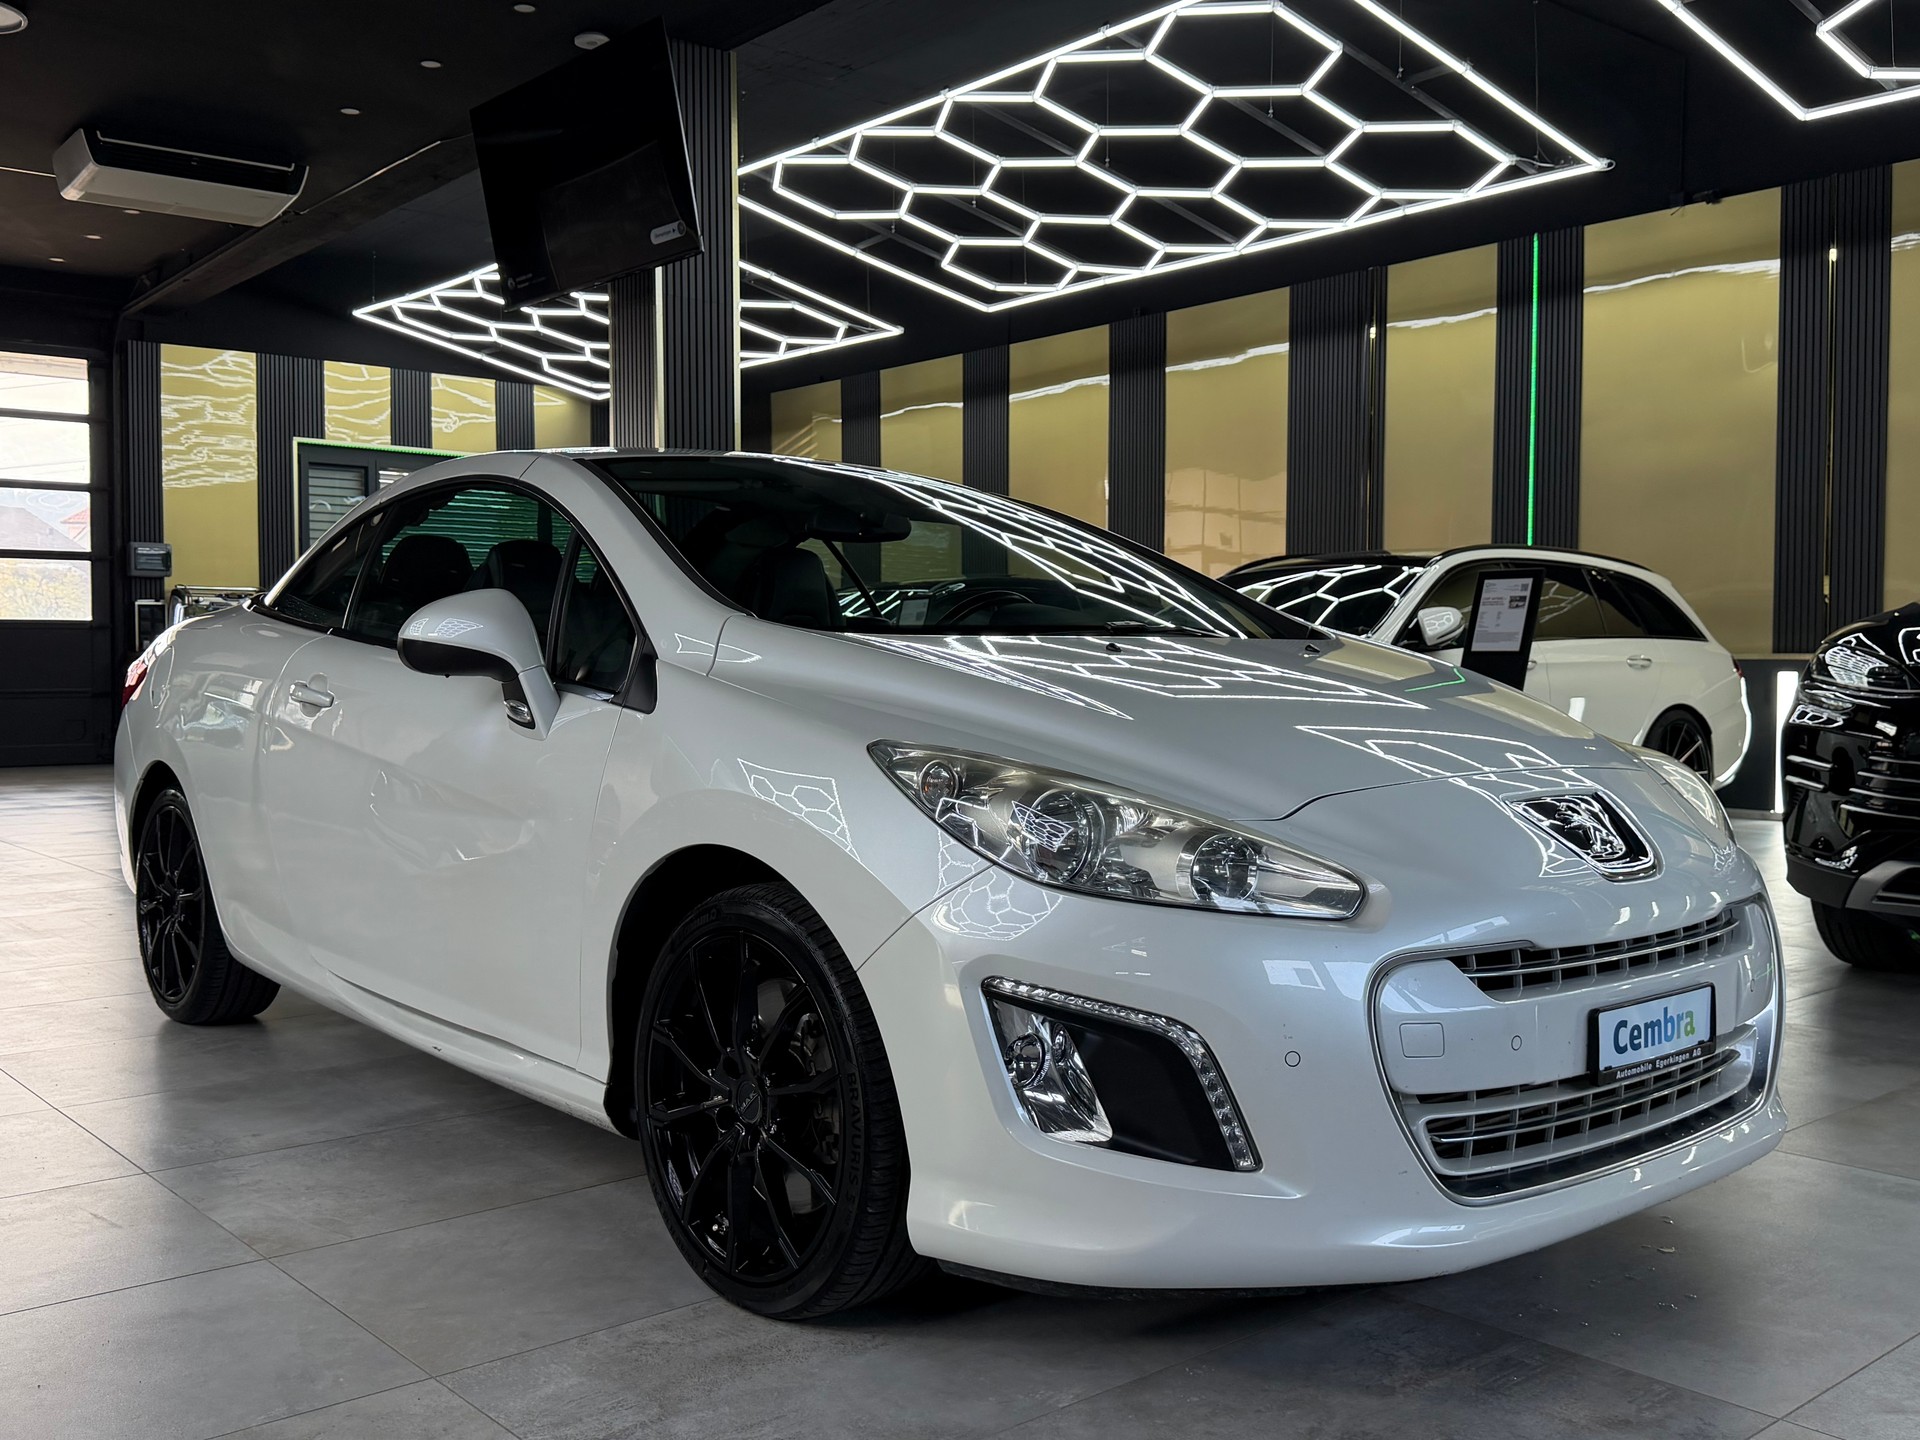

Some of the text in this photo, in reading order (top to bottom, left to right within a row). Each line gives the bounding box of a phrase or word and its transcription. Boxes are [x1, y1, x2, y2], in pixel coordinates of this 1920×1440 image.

[1613, 1006, 1695, 1055] Cembra
[1616, 1047, 1702, 1080] Automobile Egerkingen AG
[847, 1072, 862, 1186] BRAVURIS
